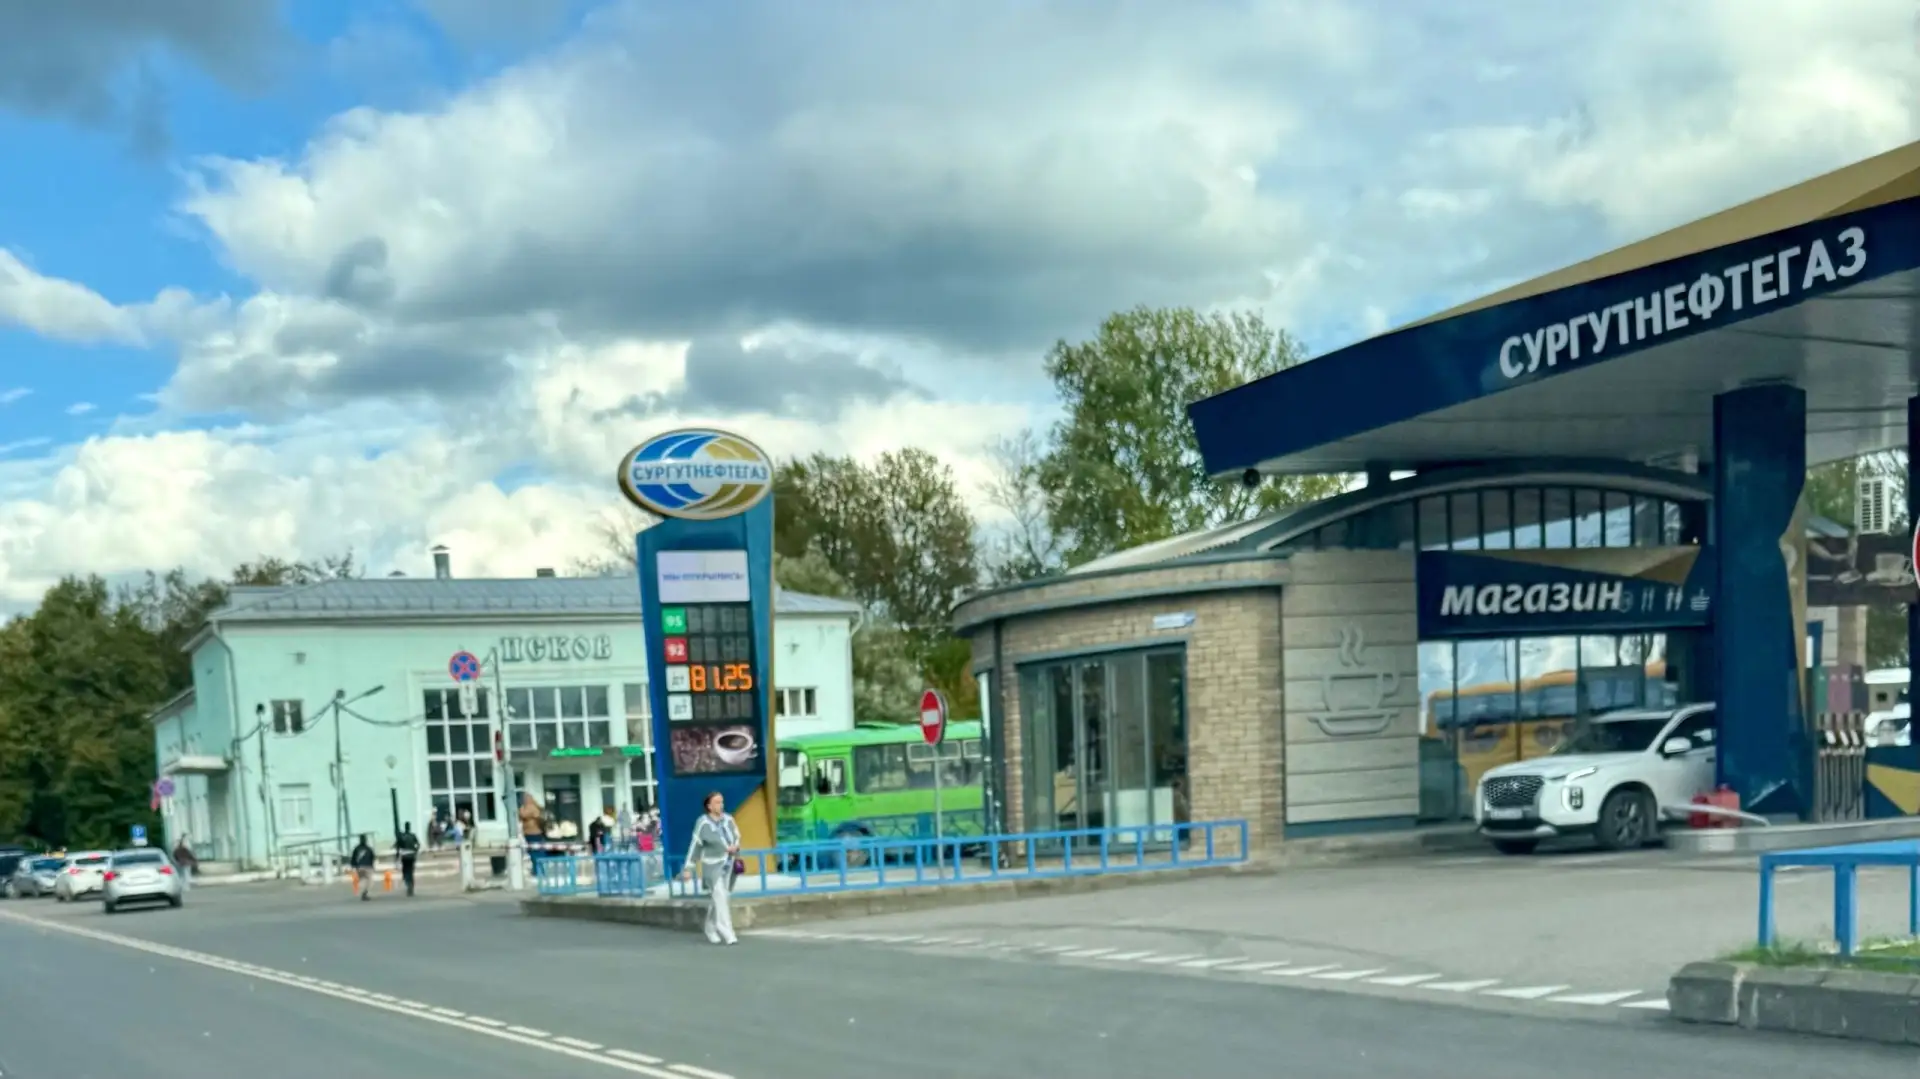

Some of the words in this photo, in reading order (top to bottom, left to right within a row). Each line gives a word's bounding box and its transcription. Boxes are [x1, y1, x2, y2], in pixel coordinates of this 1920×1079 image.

[1499, 226, 1867, 378] СУРГУТНЕФТЕГАЗ
[632, 462, 768, 481] СУРГУТНЕФТЕГАЗ
[1440, 581, 1622, 616] магазин
[665, 615, 682, 627] 95
[501, 634, 612, 662] ПСКОВ
[667, 643, 685, 656] 92
[690, 663, 753, 692] 81.25
